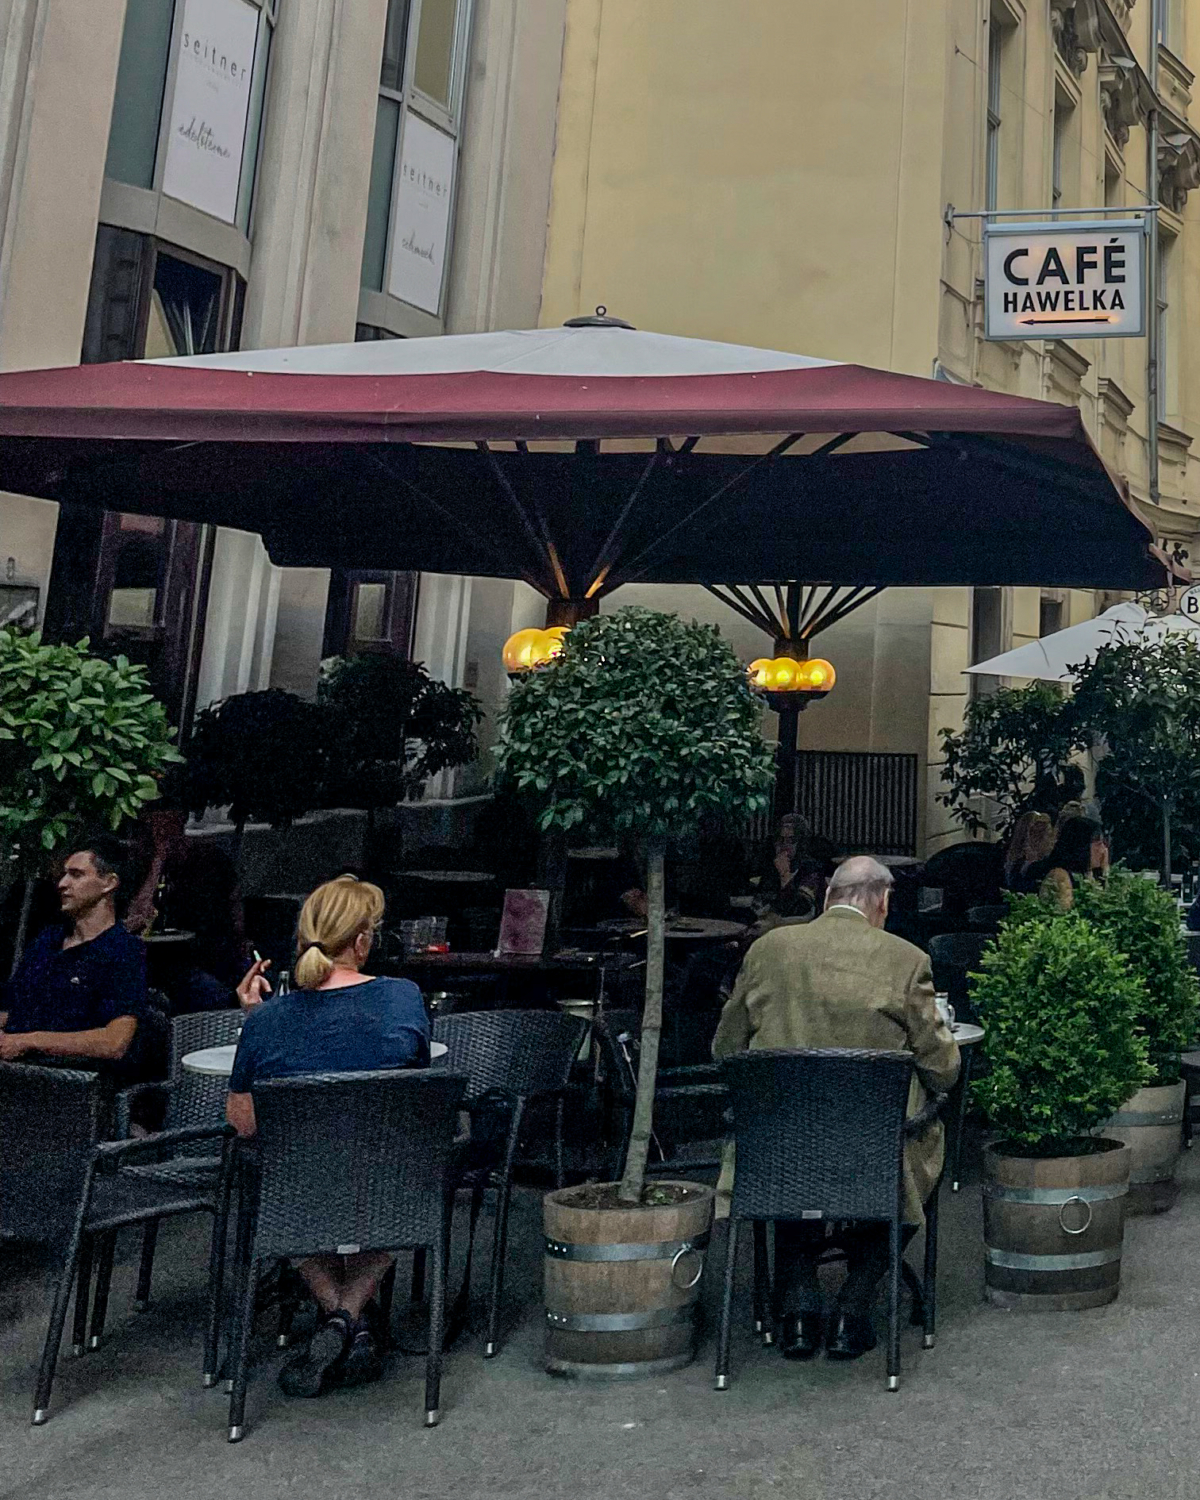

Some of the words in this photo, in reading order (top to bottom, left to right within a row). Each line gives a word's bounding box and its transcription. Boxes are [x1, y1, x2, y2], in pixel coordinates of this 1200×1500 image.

[183, 33, 247, 81] seitner
[403, 164, 447, 198] seitner
[1003, 238, 1126, 286] CAFÉ
[1003, 289, 1125, 313] HAWELKA
